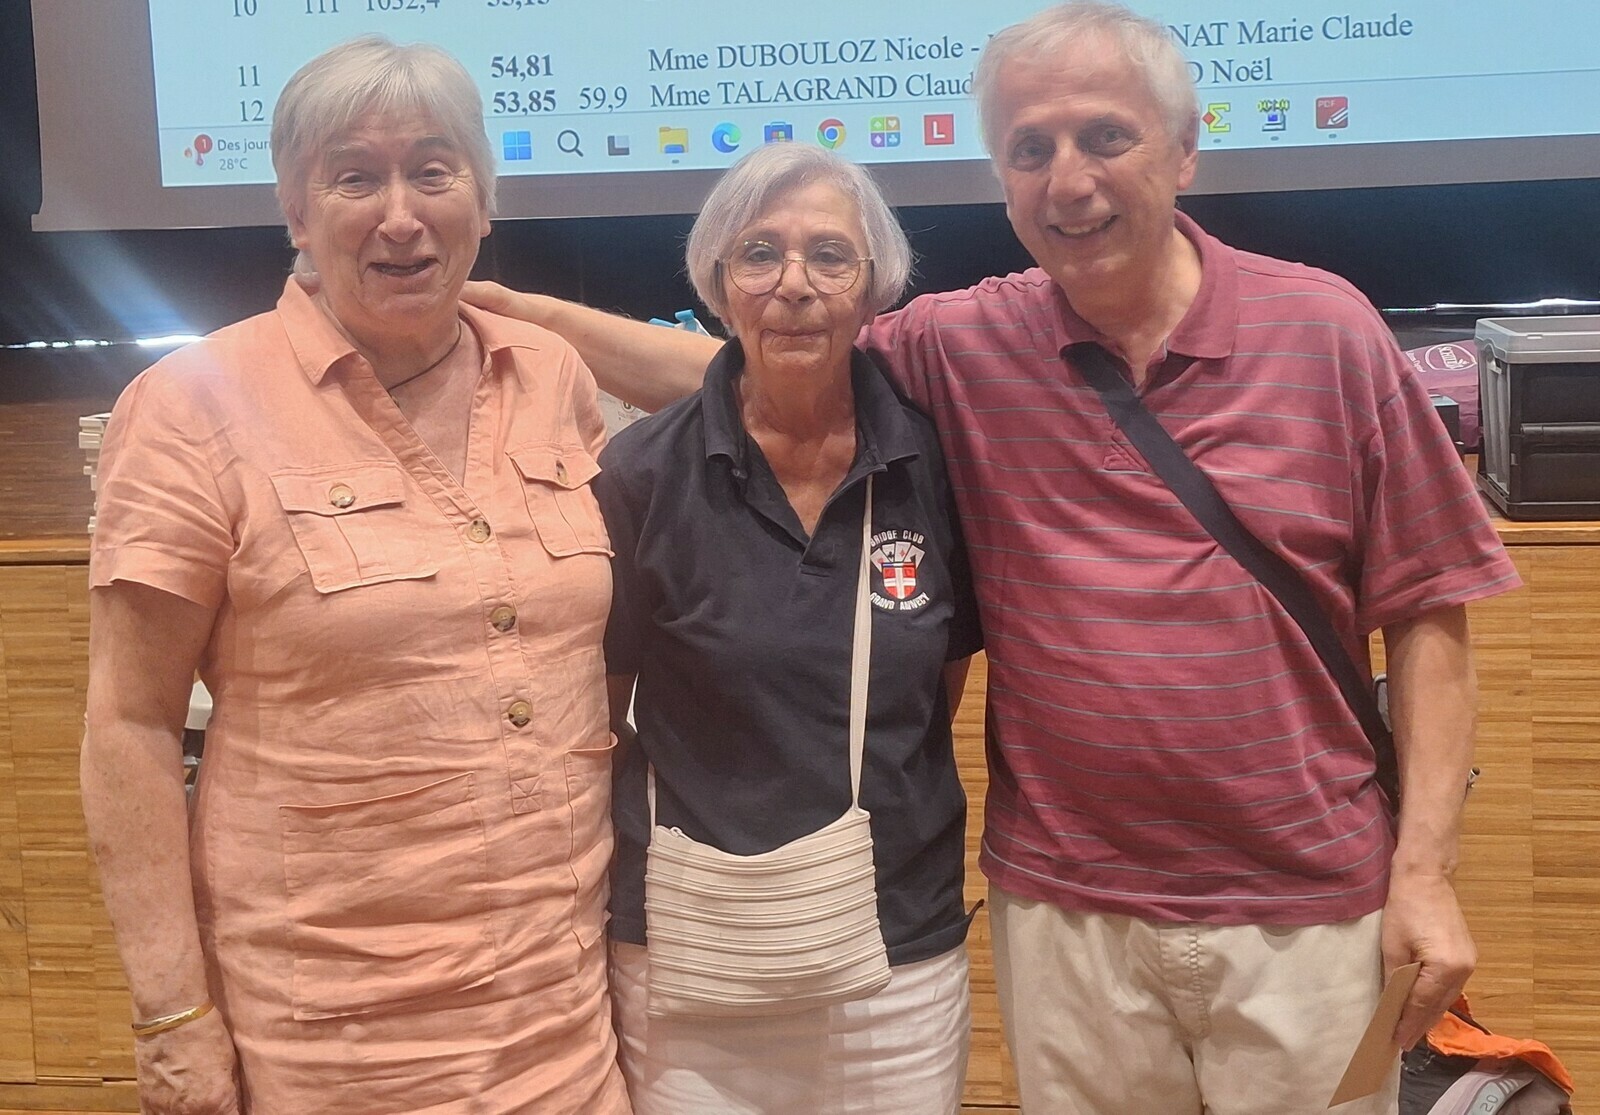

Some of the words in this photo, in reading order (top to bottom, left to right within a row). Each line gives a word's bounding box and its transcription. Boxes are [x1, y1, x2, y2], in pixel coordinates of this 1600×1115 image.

[233, 0, 258, 17] 10
[304, 0, 340, 14] 111
[238, 65, 261, 87] 11
[490, 54, 554, 82] 54,81
[648, 48, 709, 71] Mme
[716, 39, 877, 69] DUBOULOZ
[884, 35, 964, 62] Nicole
[1167, 22, 1229, 47] NAT
[1237, 18, 1314, 45] Marie
[1321, 13, 1413, 40] Claude
[240, 99, 265, 122] 12
[492, 90, 557, 116] 53,85
[578, 86, 628, 113] 59,9
[650, 84, 710, 107] Mme
[716, 75, 898, 105] TALAGRAND
[904, 71, 975, 97] Claud
[1210, 57, 1273, 83] Noël
[217, 139, 241, 152] Des
[242, 138, 269, 154] jour
[218, 158, 248, 171] 28°C
[902, 530, 925, 544] CLUB
